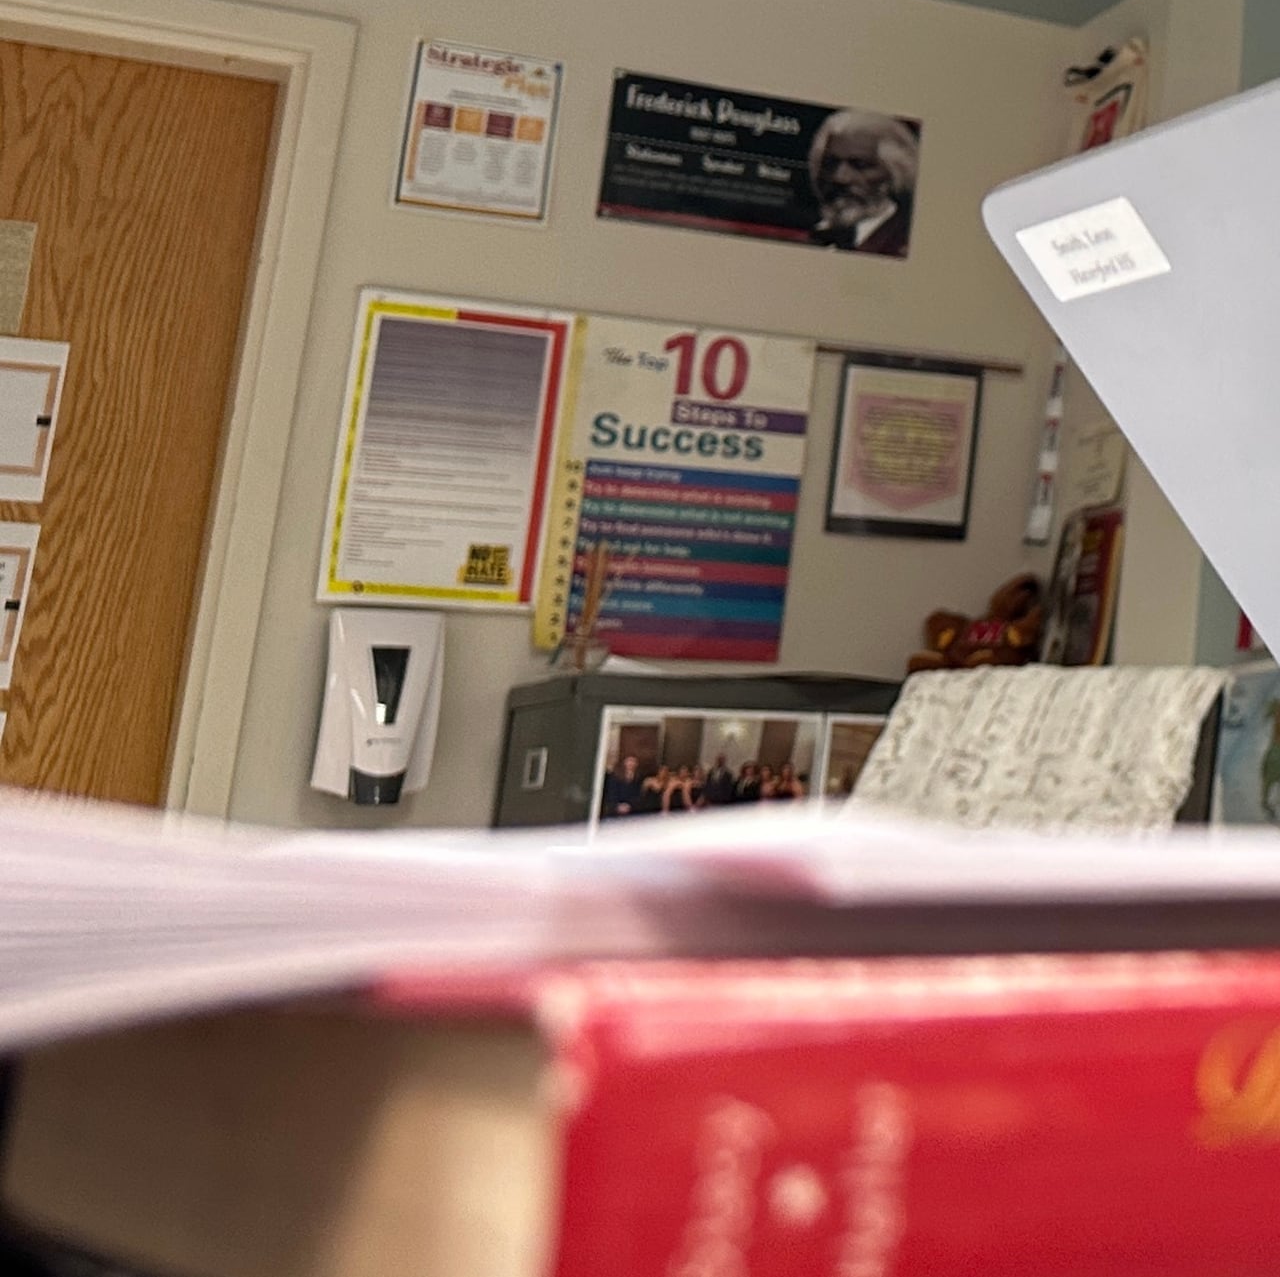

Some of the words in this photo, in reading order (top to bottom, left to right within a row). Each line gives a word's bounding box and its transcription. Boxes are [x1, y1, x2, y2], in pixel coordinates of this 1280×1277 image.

[626, 83, 713, 121] Frederick
[662, 330, 751, 401] 10
[674, 402, 739, 426] Steps
[591, 412, 767, 462] Success
